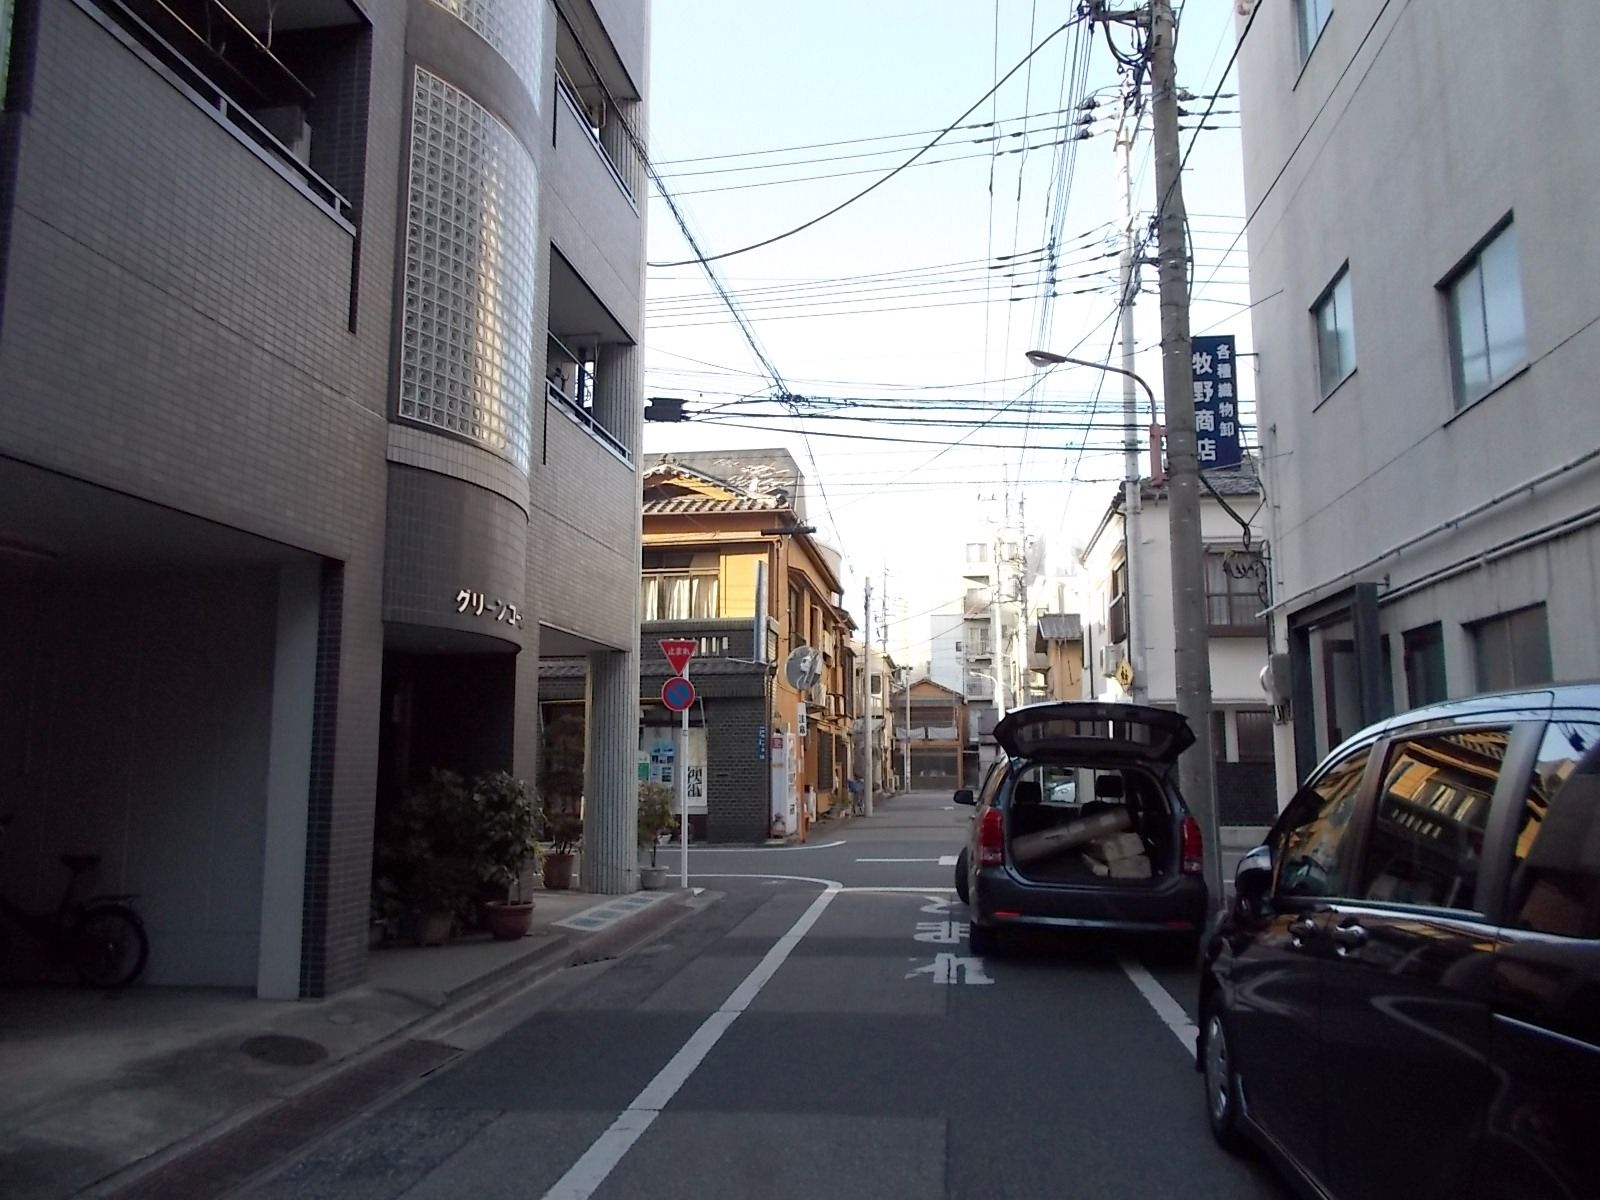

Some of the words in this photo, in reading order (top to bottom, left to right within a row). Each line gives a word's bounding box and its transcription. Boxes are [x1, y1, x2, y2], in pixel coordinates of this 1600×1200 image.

[1192, 351, 1217, 462] 牧野商店
[667, 647, 691, 657] 止まれ
